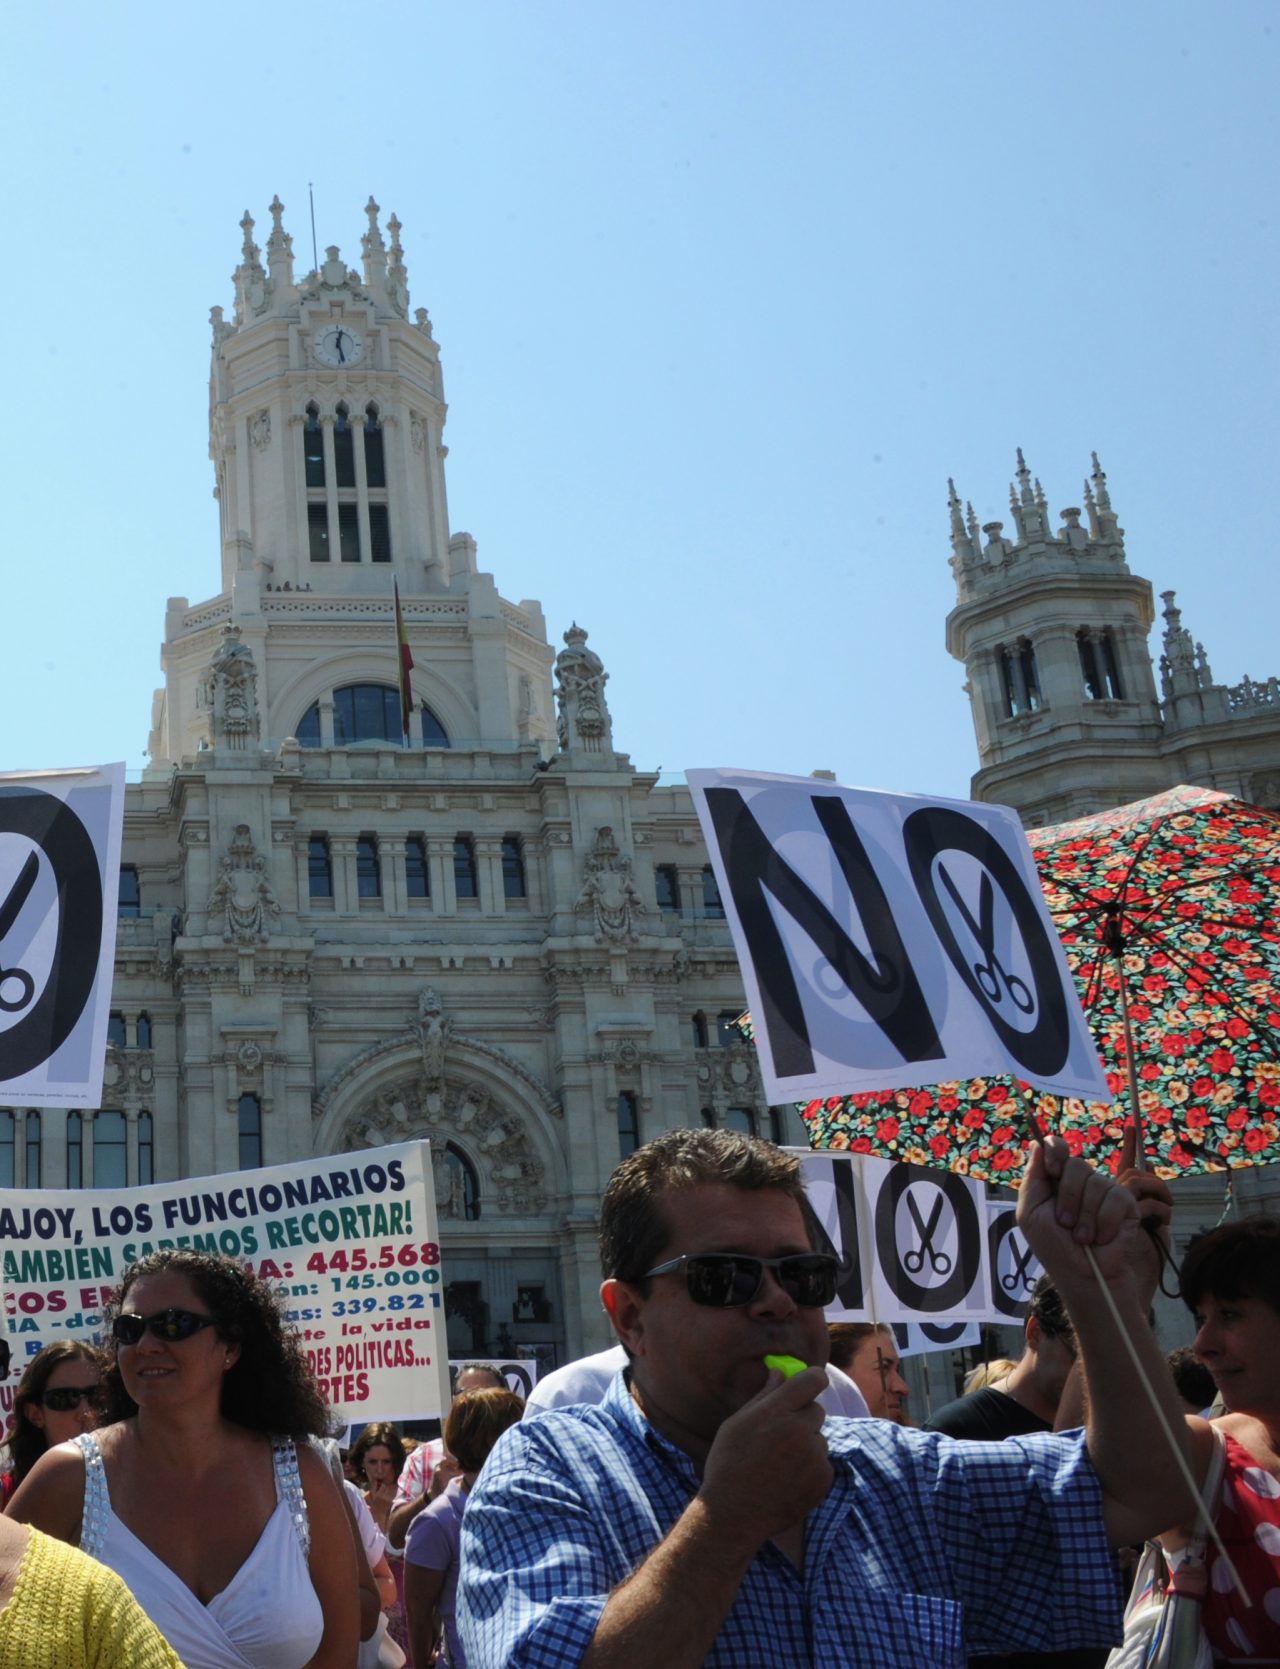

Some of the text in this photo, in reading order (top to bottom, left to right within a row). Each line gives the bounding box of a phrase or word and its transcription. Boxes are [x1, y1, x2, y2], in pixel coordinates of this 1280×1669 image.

[703, 787, 1070, 1078] NO
[92, 1203, 153, 1237] LOS
[162, 1160, 406, 1229] FUNCIONARIOS
[265, 1200, 413, 1250] RECORTAR!
[306, 1242, 441, 1275] 445.568
[274, 1269, 440, 1298] ón: 145.000
[283, 1293, 441, 1323] as: 339.821
[342, 1323, 363, 1336] la
[371, 1317, 431, 1332] vida
[307, 1346, 332, 1376] DES
